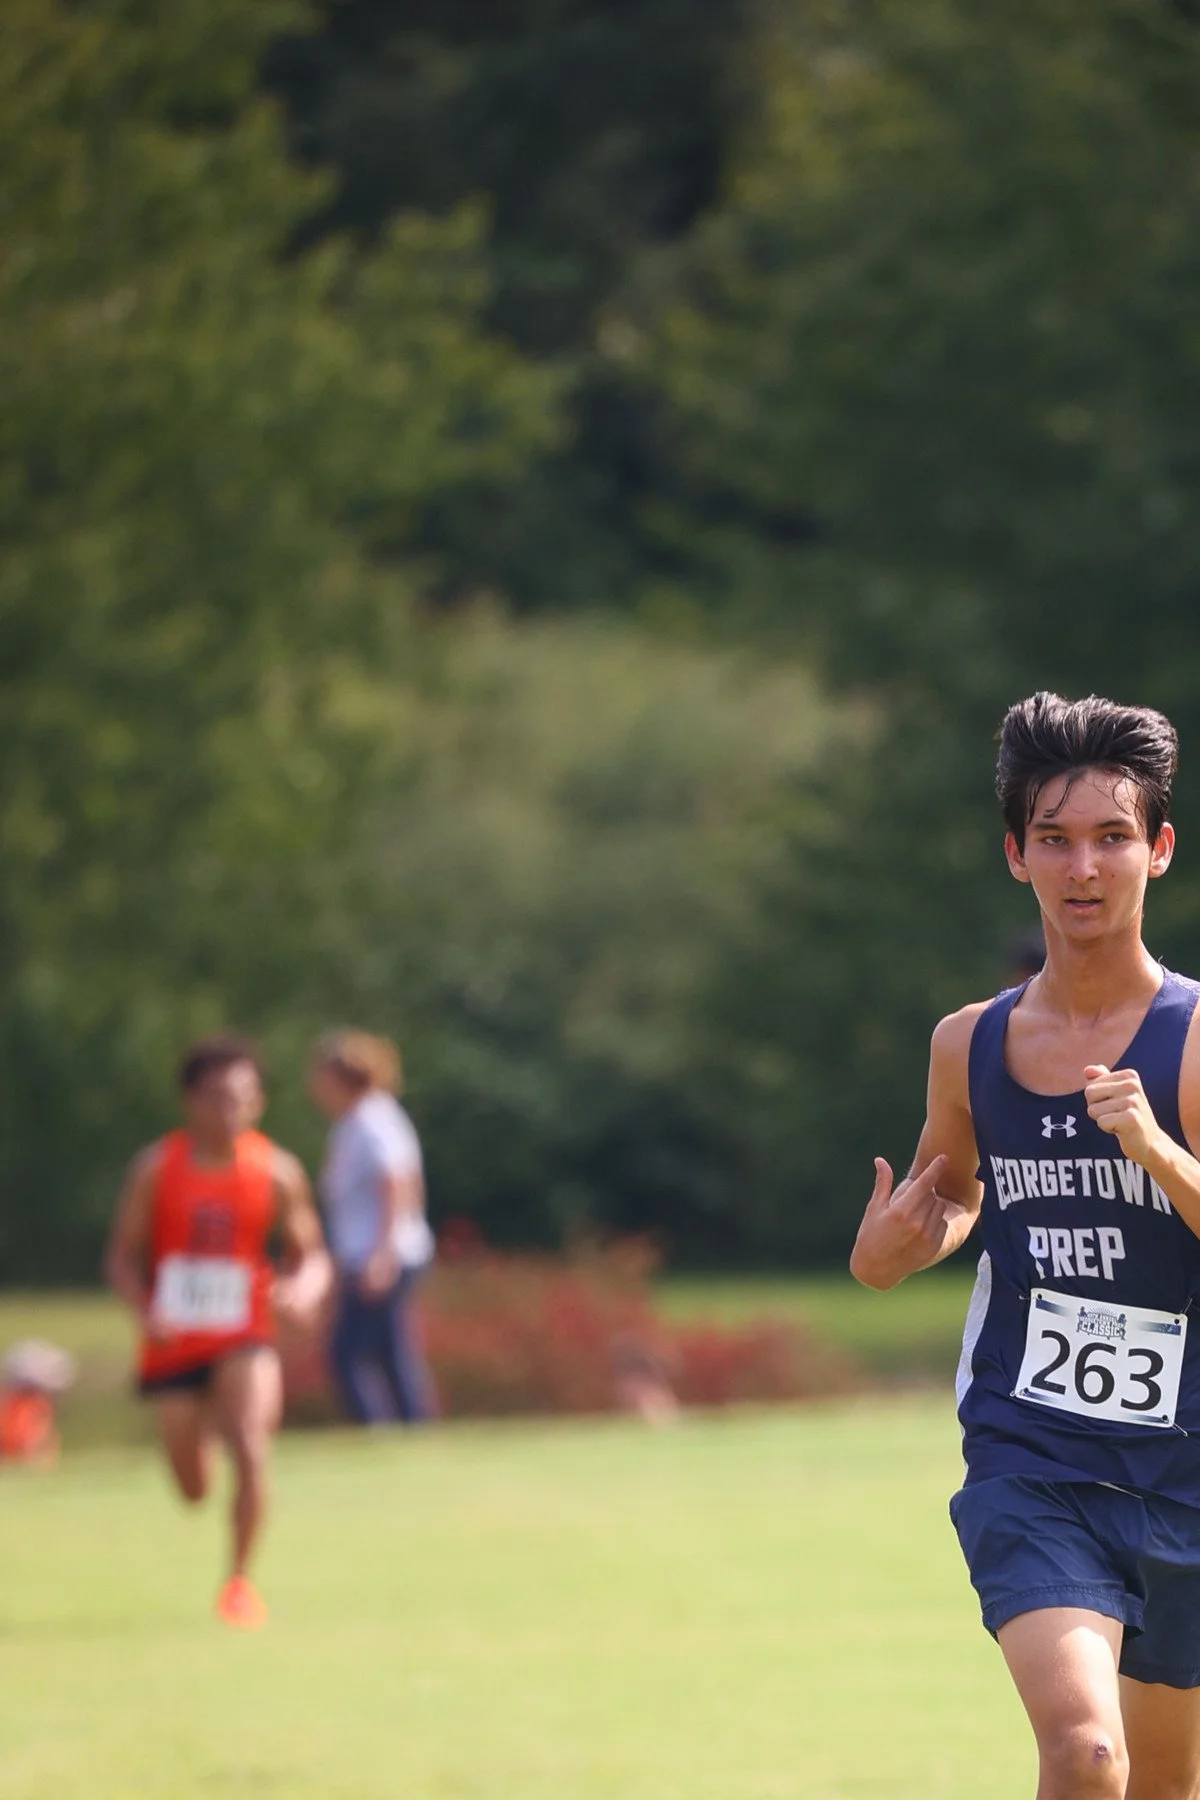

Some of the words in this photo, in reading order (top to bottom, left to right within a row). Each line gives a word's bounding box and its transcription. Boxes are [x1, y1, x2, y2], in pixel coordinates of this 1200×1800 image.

[1027, 1225, 1126, 1281] PREP
[1081, 1320, 1121, 1337] CLASSIC
[1030, 1329, 1164, 1411] 263
